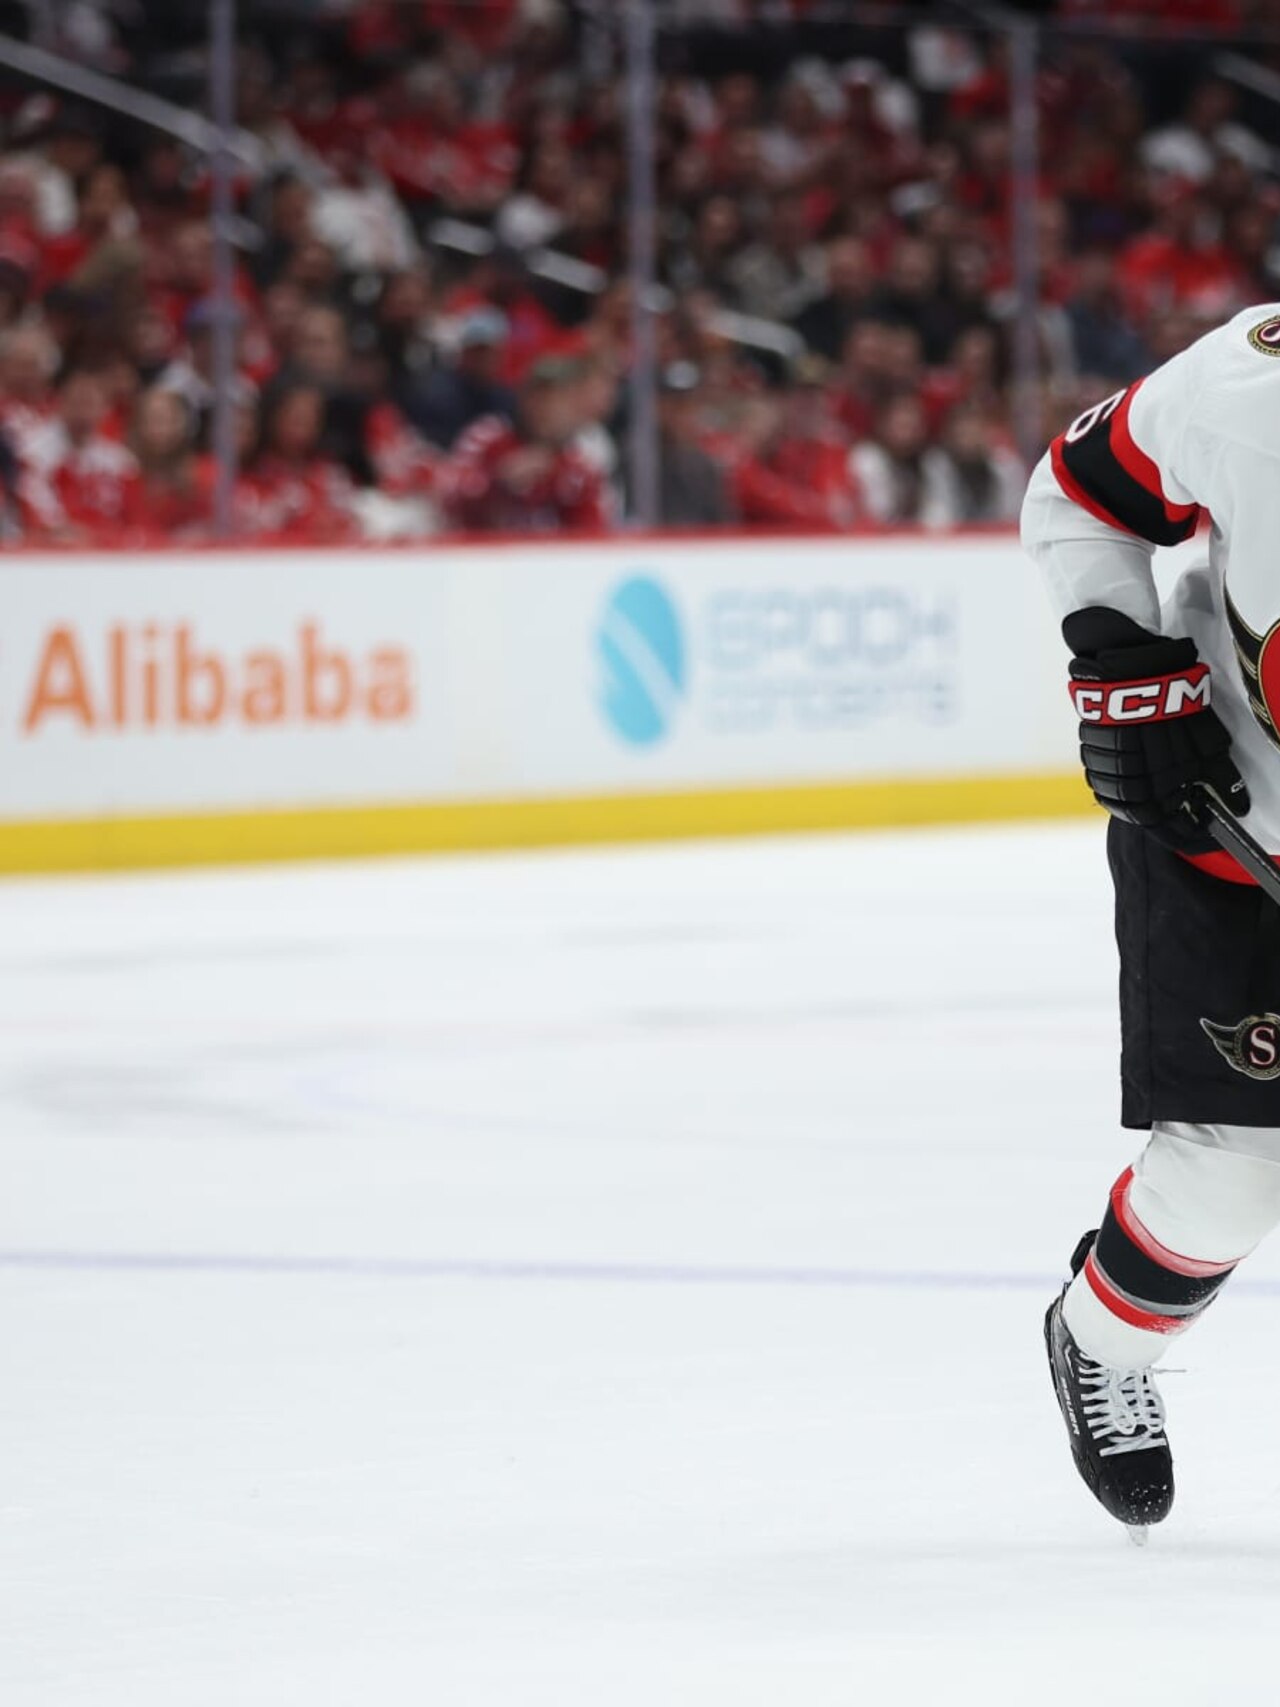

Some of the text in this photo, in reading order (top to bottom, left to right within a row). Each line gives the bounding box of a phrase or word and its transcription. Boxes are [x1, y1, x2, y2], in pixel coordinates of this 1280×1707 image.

[1064, 388, 1128, 444] 6
[20, 614, 416, 736] Alibaba
[1075, 673, 1212, 721] CCM
[1249, 1025, 1277, 1066] S
